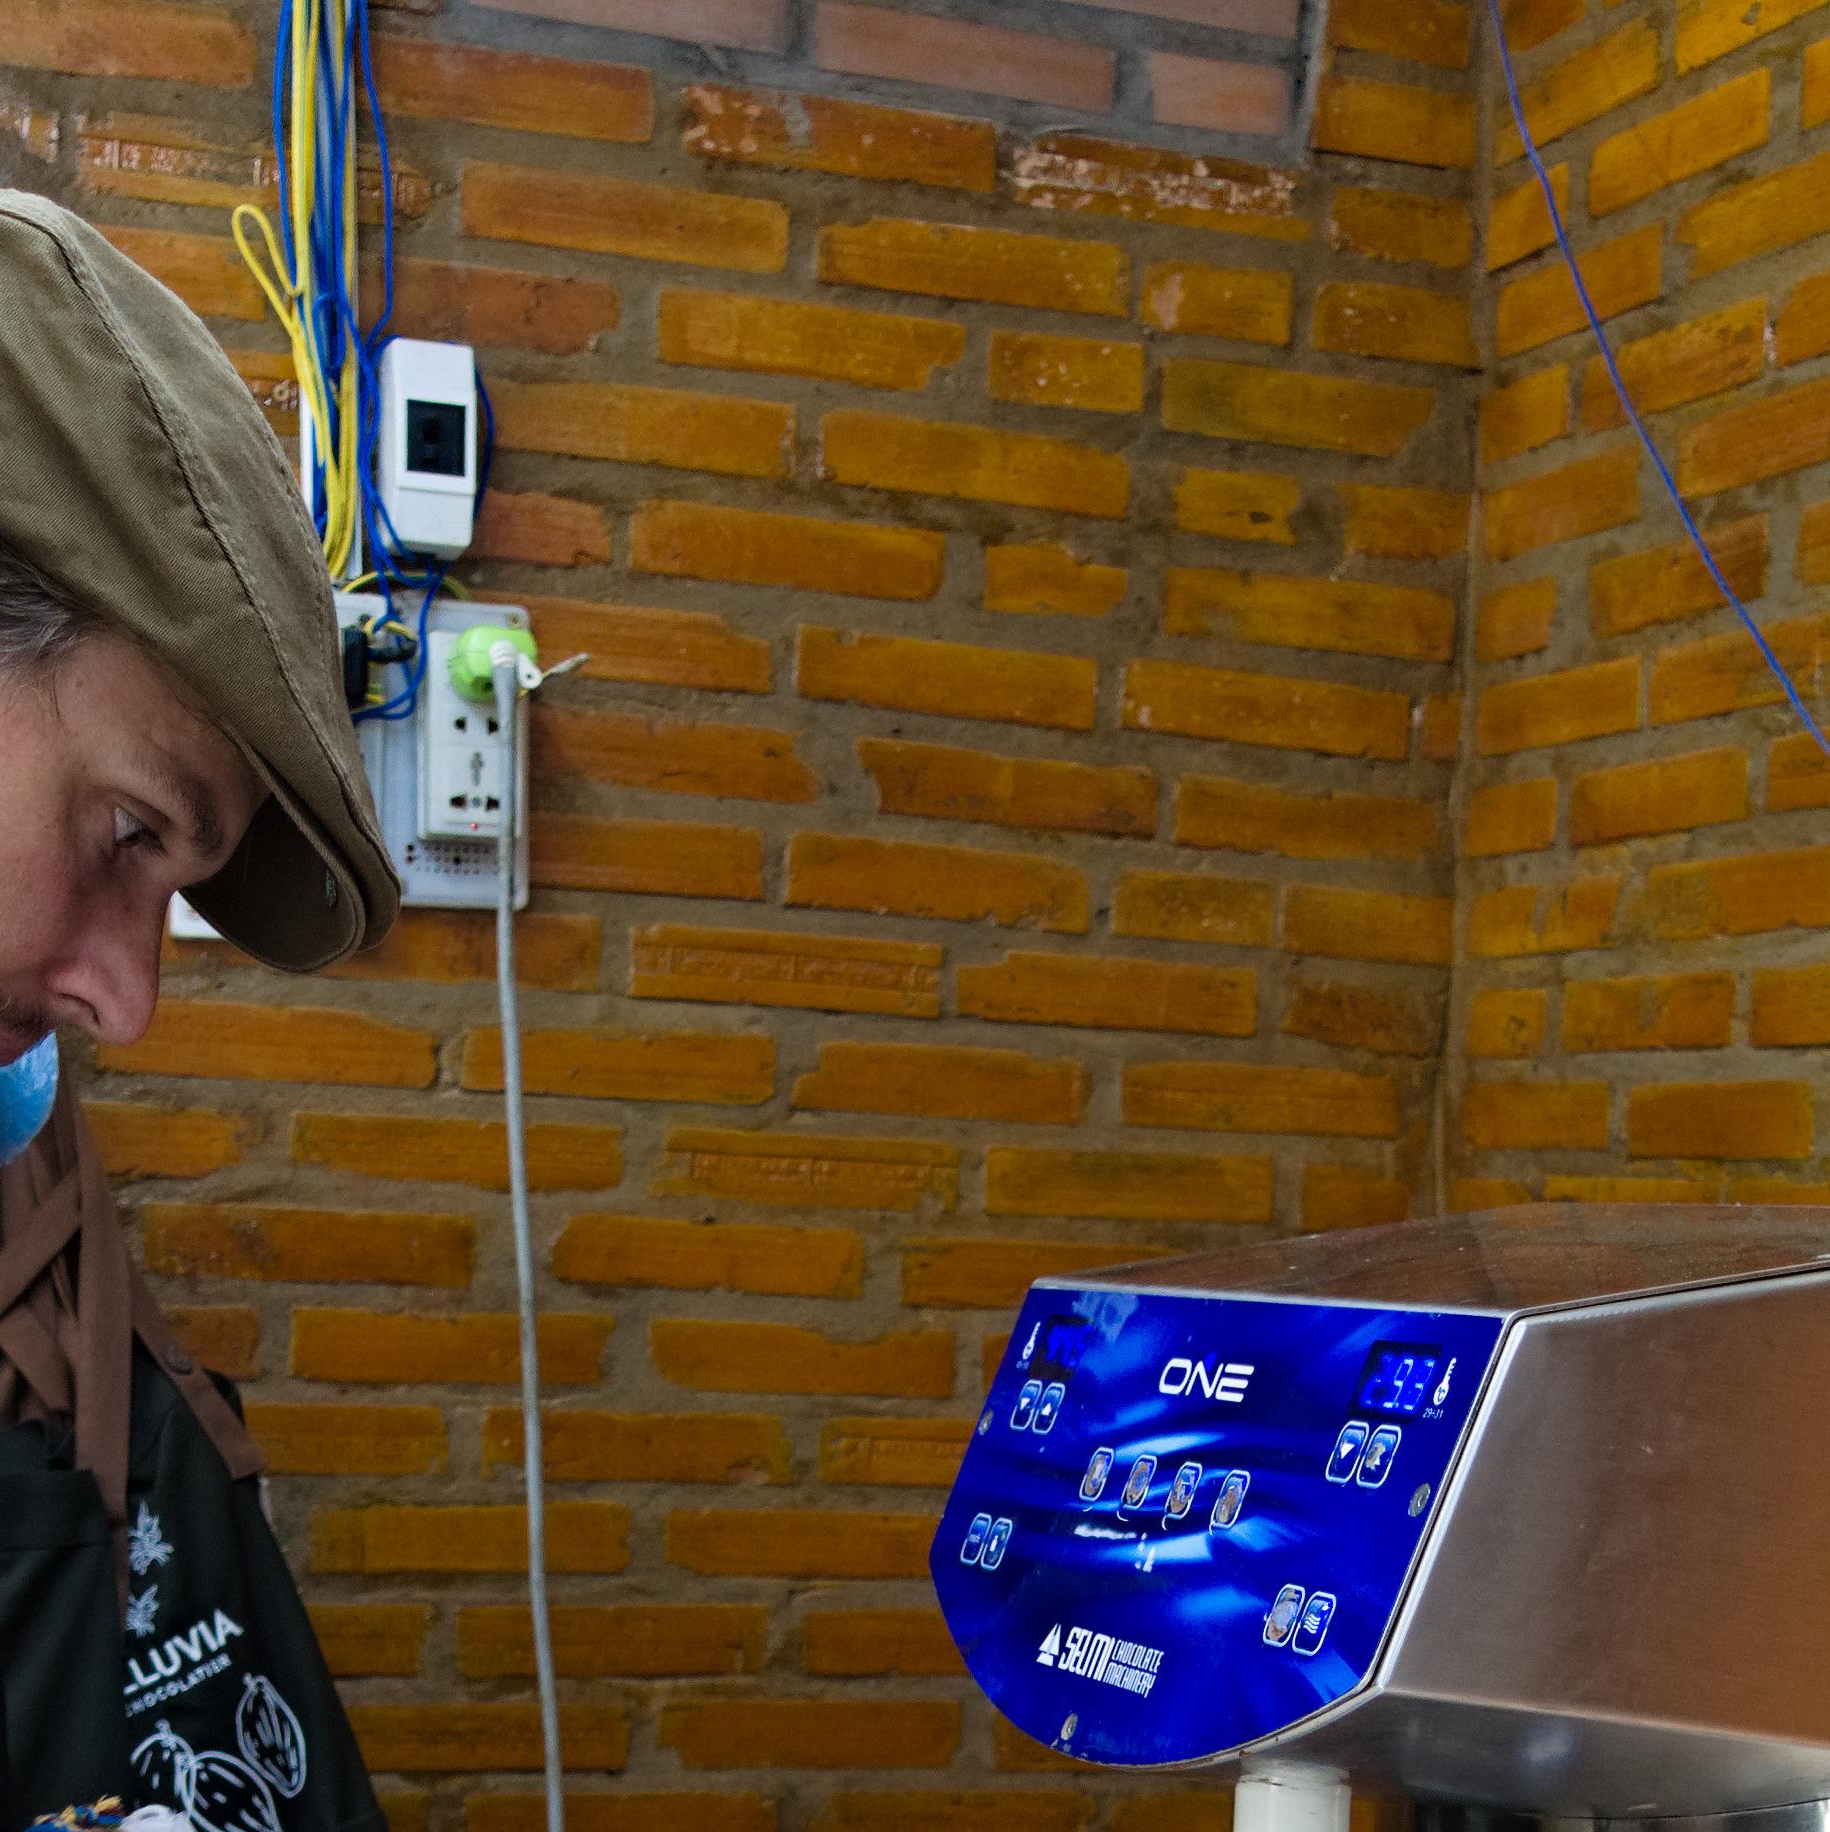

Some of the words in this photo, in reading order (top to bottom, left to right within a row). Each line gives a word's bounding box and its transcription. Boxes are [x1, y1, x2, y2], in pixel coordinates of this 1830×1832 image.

[1159, 1357, 1255, 1403] ONE
[123, 1608, 244, 1695] LUVIA
[1058, 1626, 1116, 1682] SELMI
[1111, 1639, 1165, 1673] CHOCOLATE
[1102, 1661, 1157, 1699] MACHINERY
